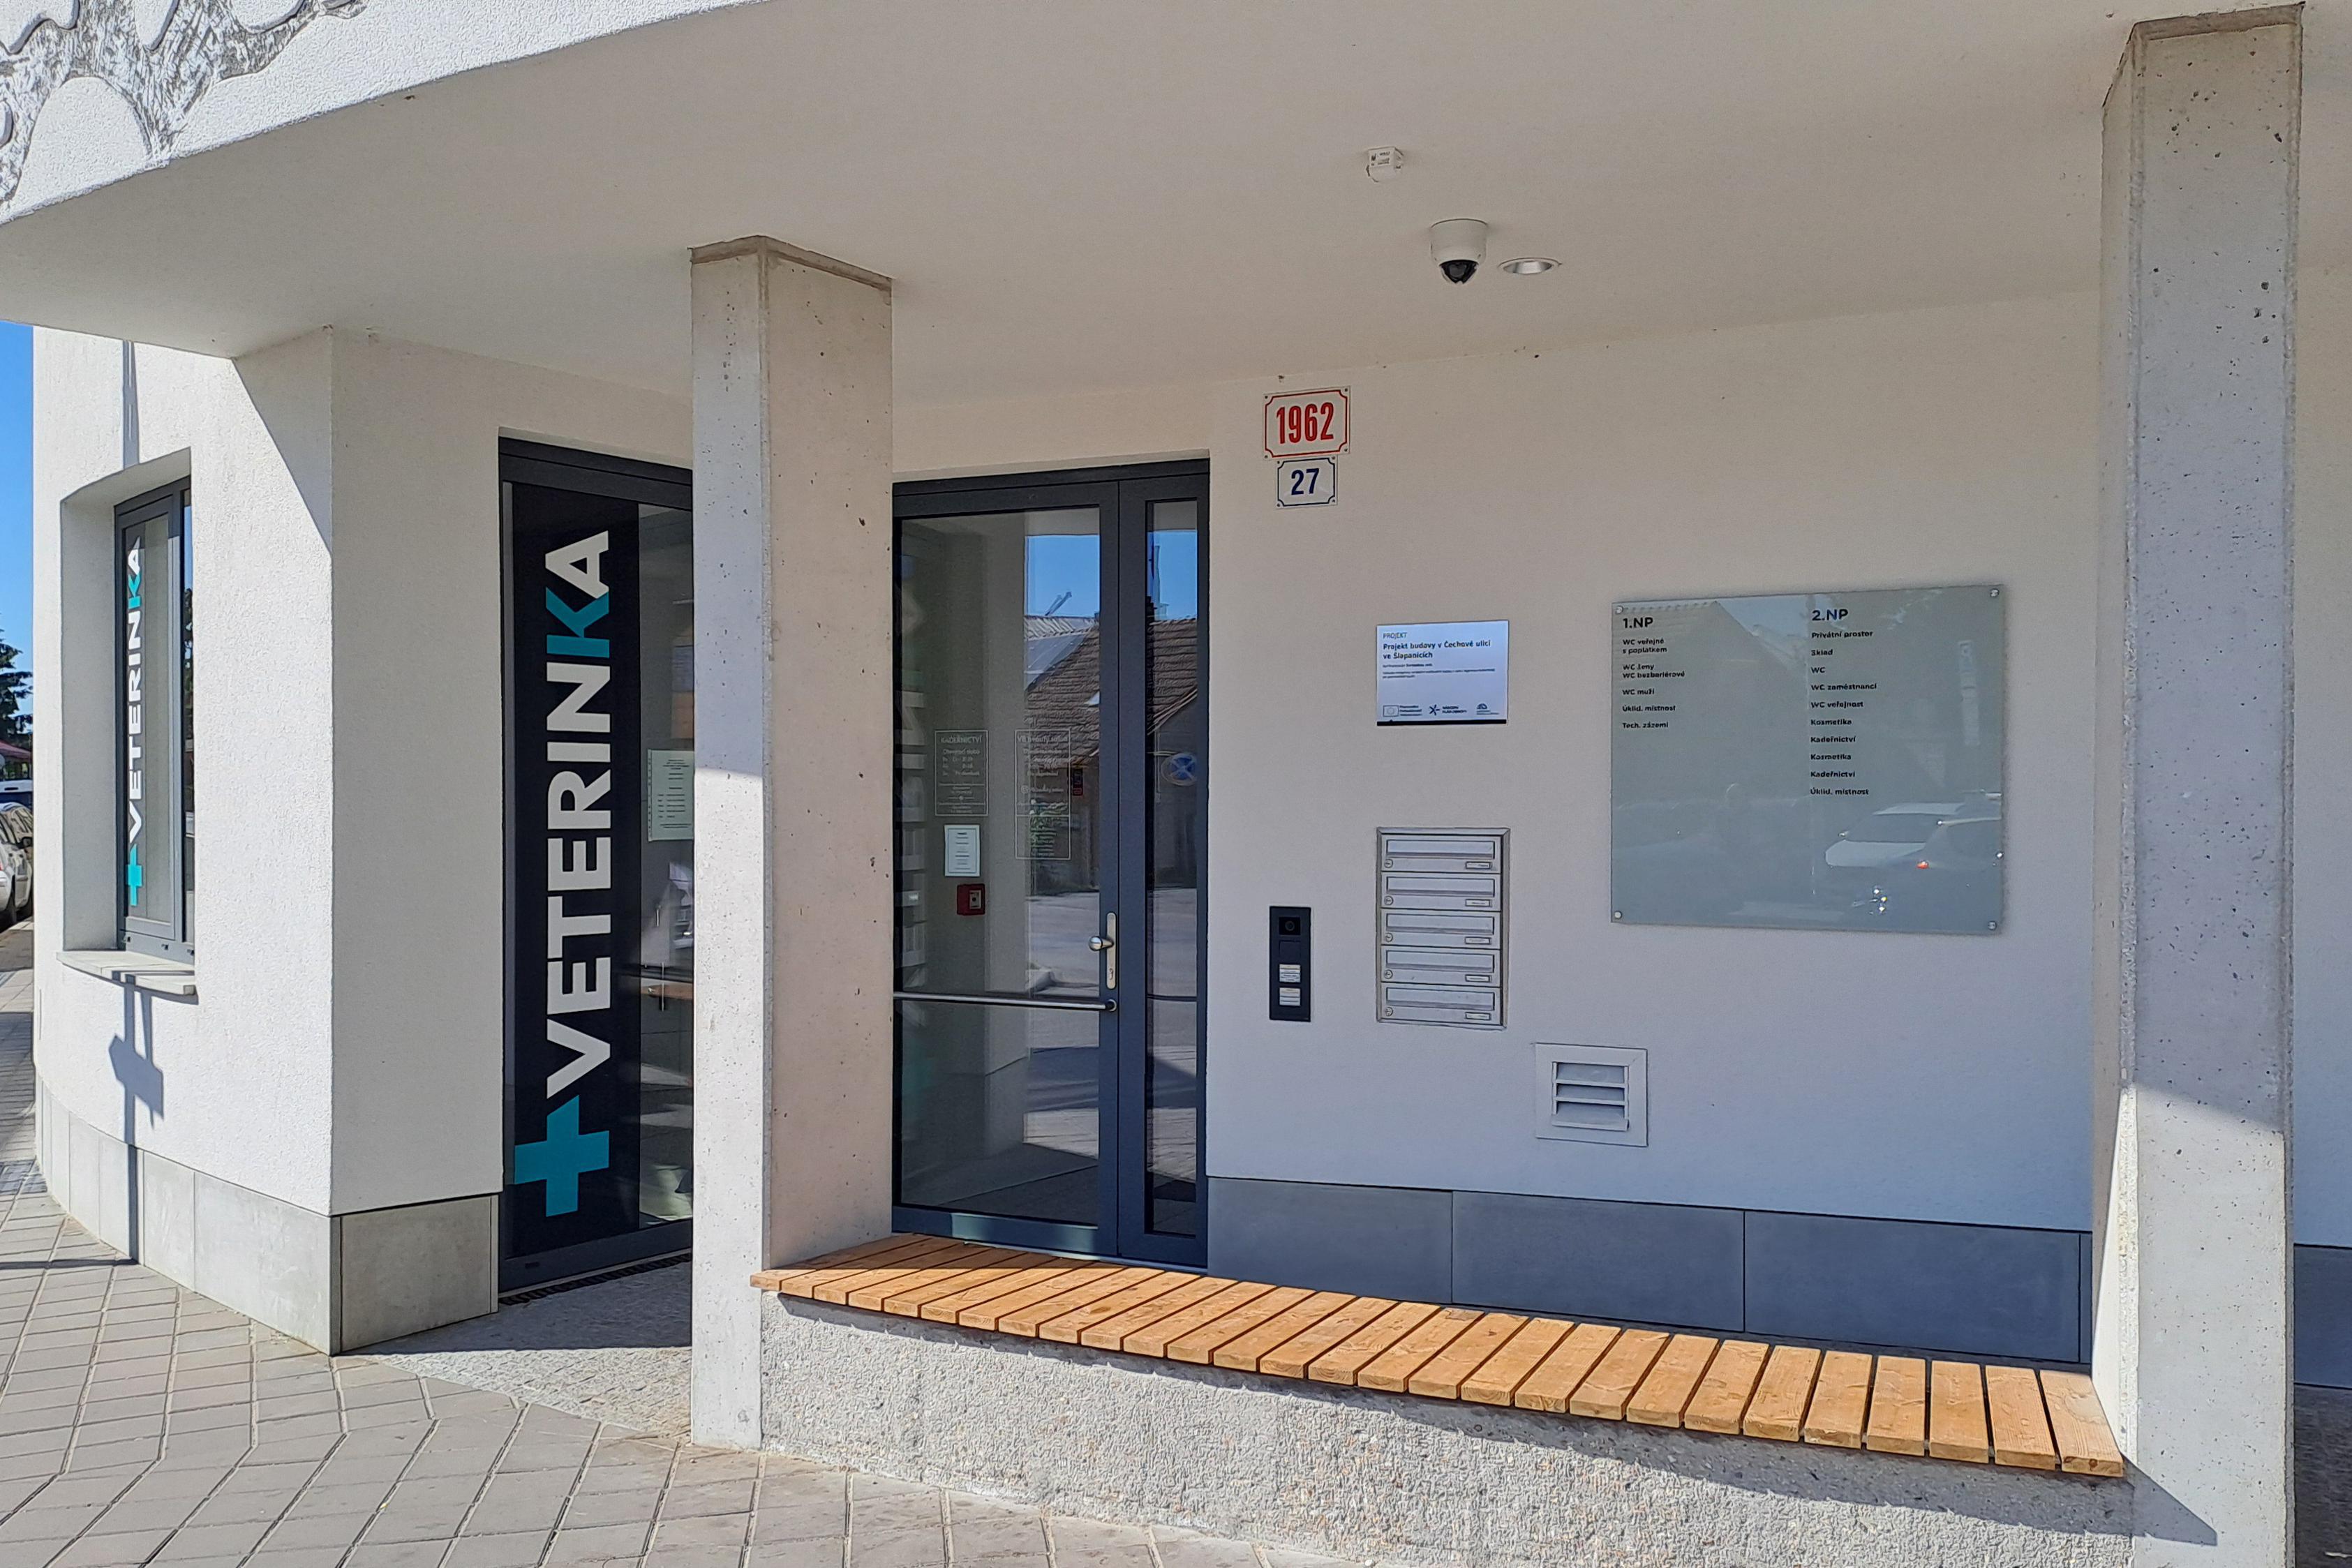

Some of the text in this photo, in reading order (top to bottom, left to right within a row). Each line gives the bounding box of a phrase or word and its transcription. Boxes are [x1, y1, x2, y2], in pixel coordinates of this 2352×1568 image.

[1276, 401, 1334, 445] 1962
[1291, 468, 1320, 495] 27
[1623, 617, 1653, 629] 1.NP
[1812, 608, 1849, 621] 2.NP
[1410, 641, 1436, 650] budovy
[1393, 652, 1433, 660] Šlapanicích
[128, 536, 142, 844] VETERINKA
[545, 530, 611, 1100] VETERINKA
